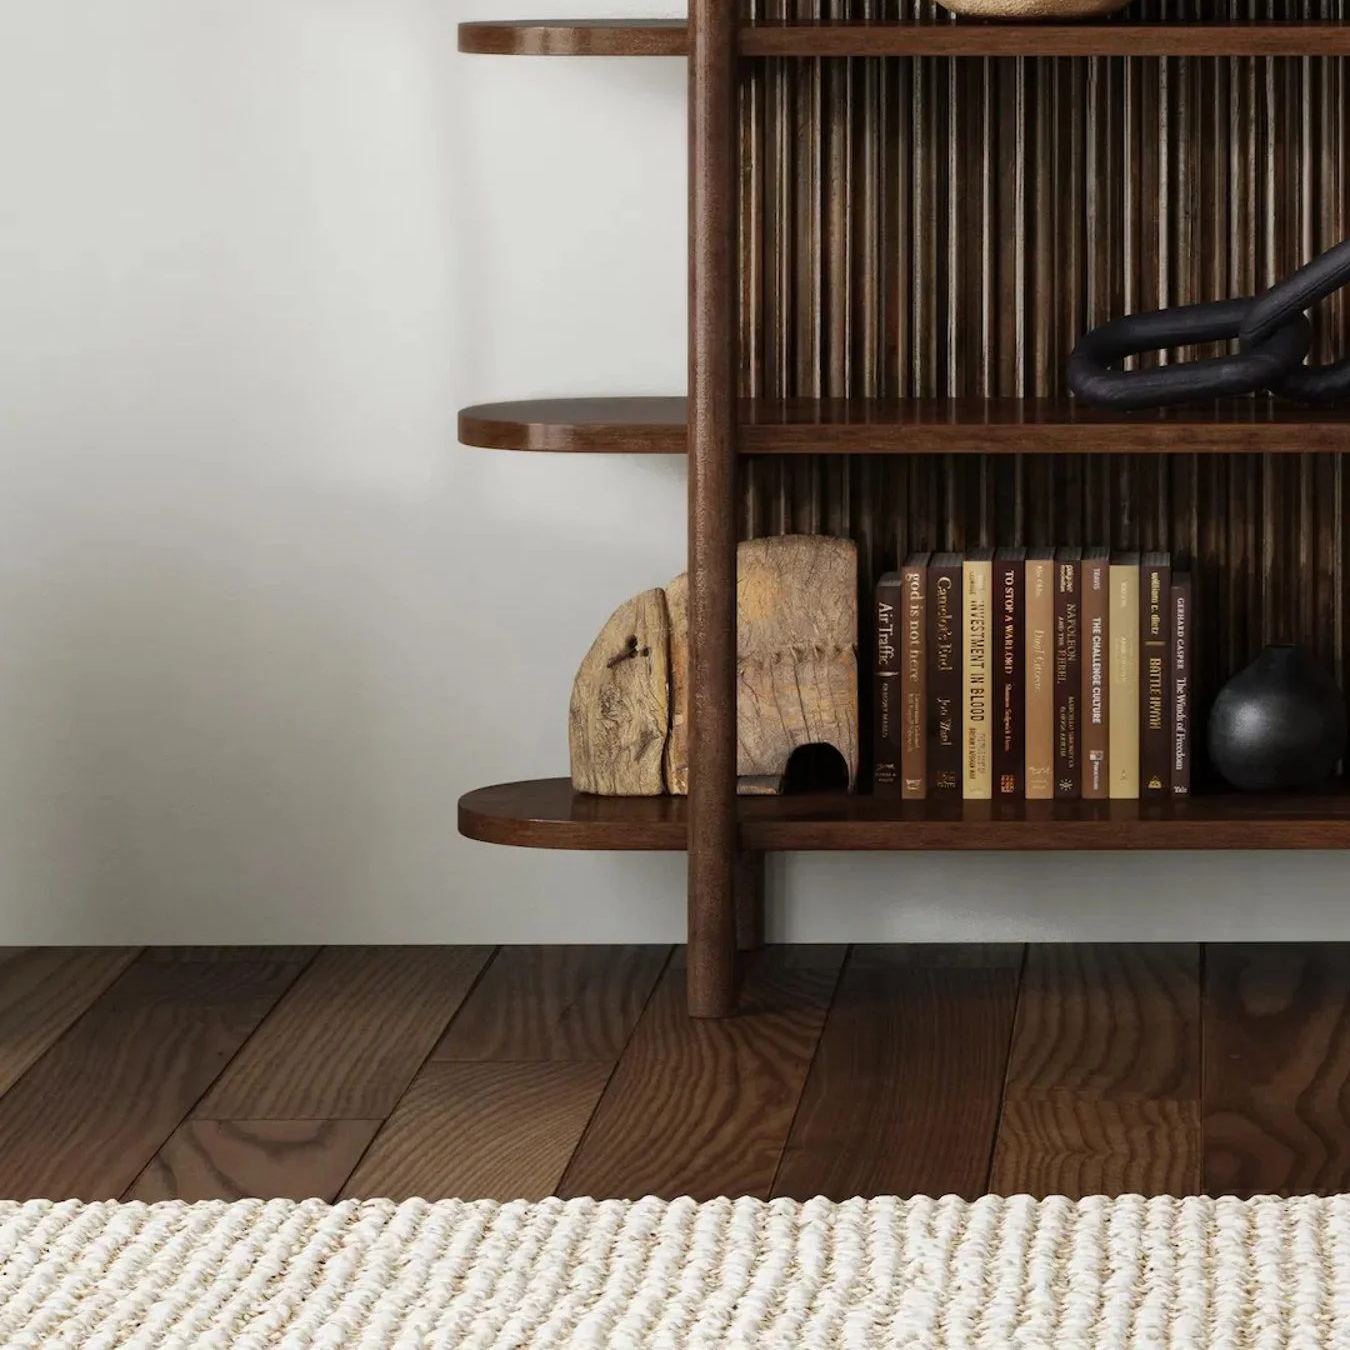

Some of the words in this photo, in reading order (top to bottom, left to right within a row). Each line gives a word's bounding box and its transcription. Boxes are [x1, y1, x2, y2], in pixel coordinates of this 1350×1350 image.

[906, 573, 924, 600] god
[1004, 570, 1014, 585] TO
[1093, 568, 1101, 590] TRAVIS
[878, 602, 893, 618] Air
[910, 605, 924, 617] is
[1004, 587, 1014, 612] STOP
[1004, 614, 1014, 622] A
[1092, 617, 1102, 633] THE
[1150, 614, 1159, 635] dietz
[1177, 597, 1185, 637] GERHARD
[878, 624, 893, 666] Traffic
[909, 619, 922, 645] not
[970, 600, 984, 668] INVESTMENT
[1066, 603, 1077, 662] NAPOLEON
[937, 644, 953, 671] End
[1004, 624, 1014, 674] WARLORD
[1092, 635, 1102, 685] CHALLENGE
[1177, 639, 1185, 670] CASPER
[909, 649, 923, 682] here
[970, 673, 984, 683] IN
[1149, 657, 1162, 694] BATTLE
[1176, 677, 1187, 694] The
[970, 688, 984, 722] BLOOD
[1092, 687, 1102, 724] CULTURE
[1176, 694, 1187, 722] Winds
[1176, 722, 1187, 733] of
[1176, 733, 1187, 771] Freedom
